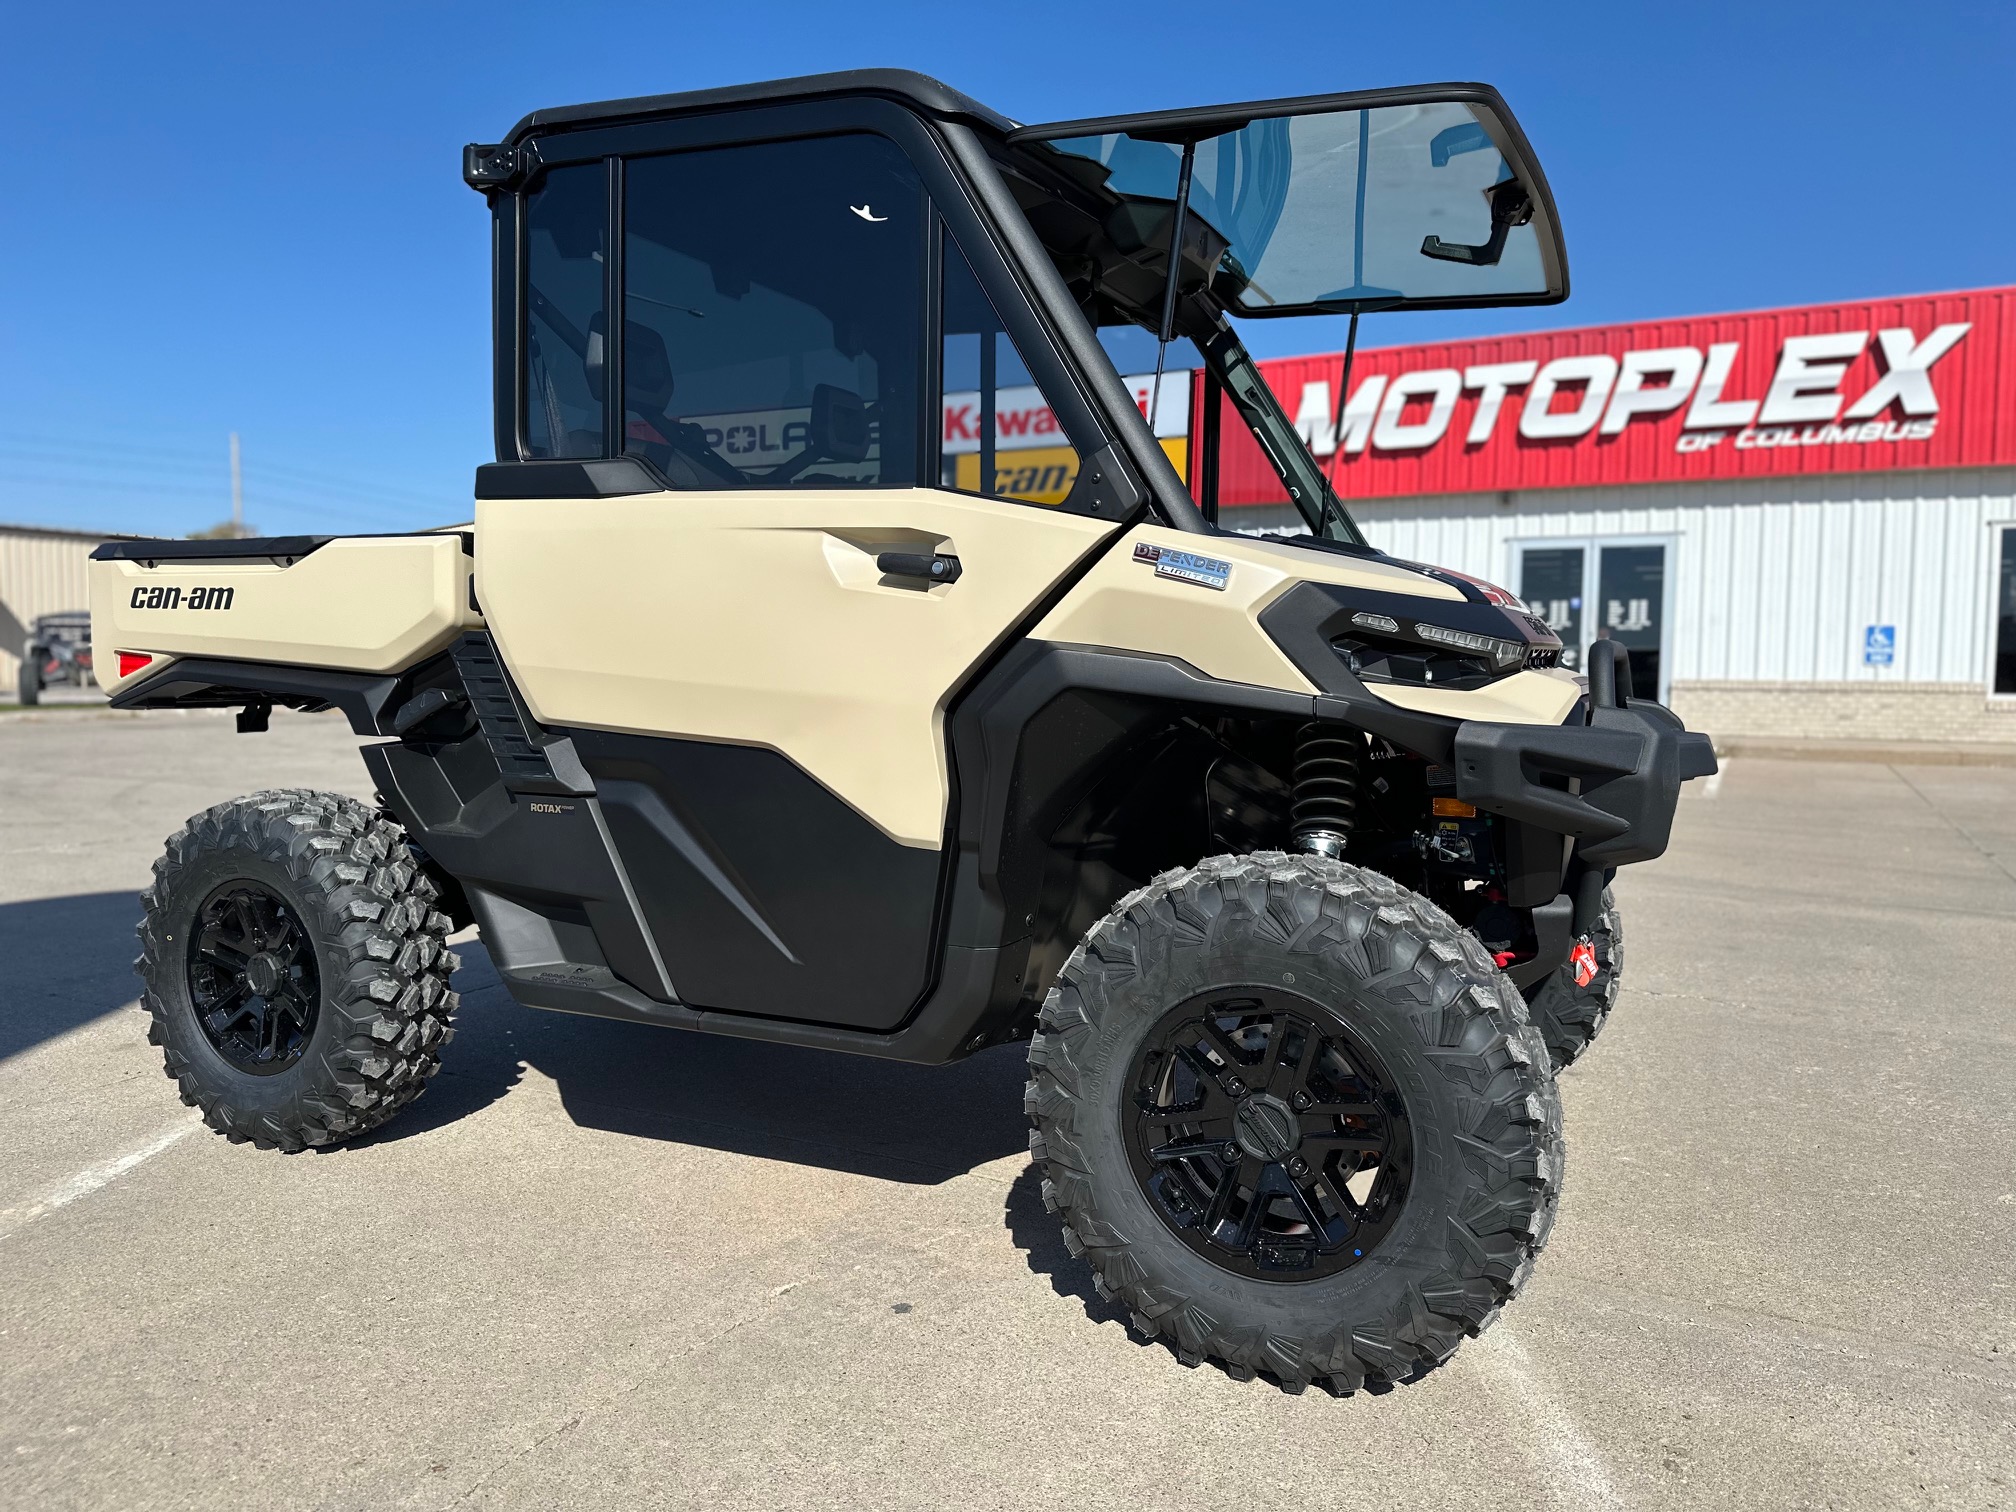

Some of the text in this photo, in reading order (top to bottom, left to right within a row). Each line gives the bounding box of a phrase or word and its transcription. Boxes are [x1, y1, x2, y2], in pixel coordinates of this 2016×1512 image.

[1294, 322, 1973, 456] MOTOPLEX
[1676, 418, 1938, 453] OF COLUMBUS
[1134, 543, 1233, 575] DEFENDER
[130, 587, 235, 610] can-am
[530, 802, 562, 814] ROTAX
